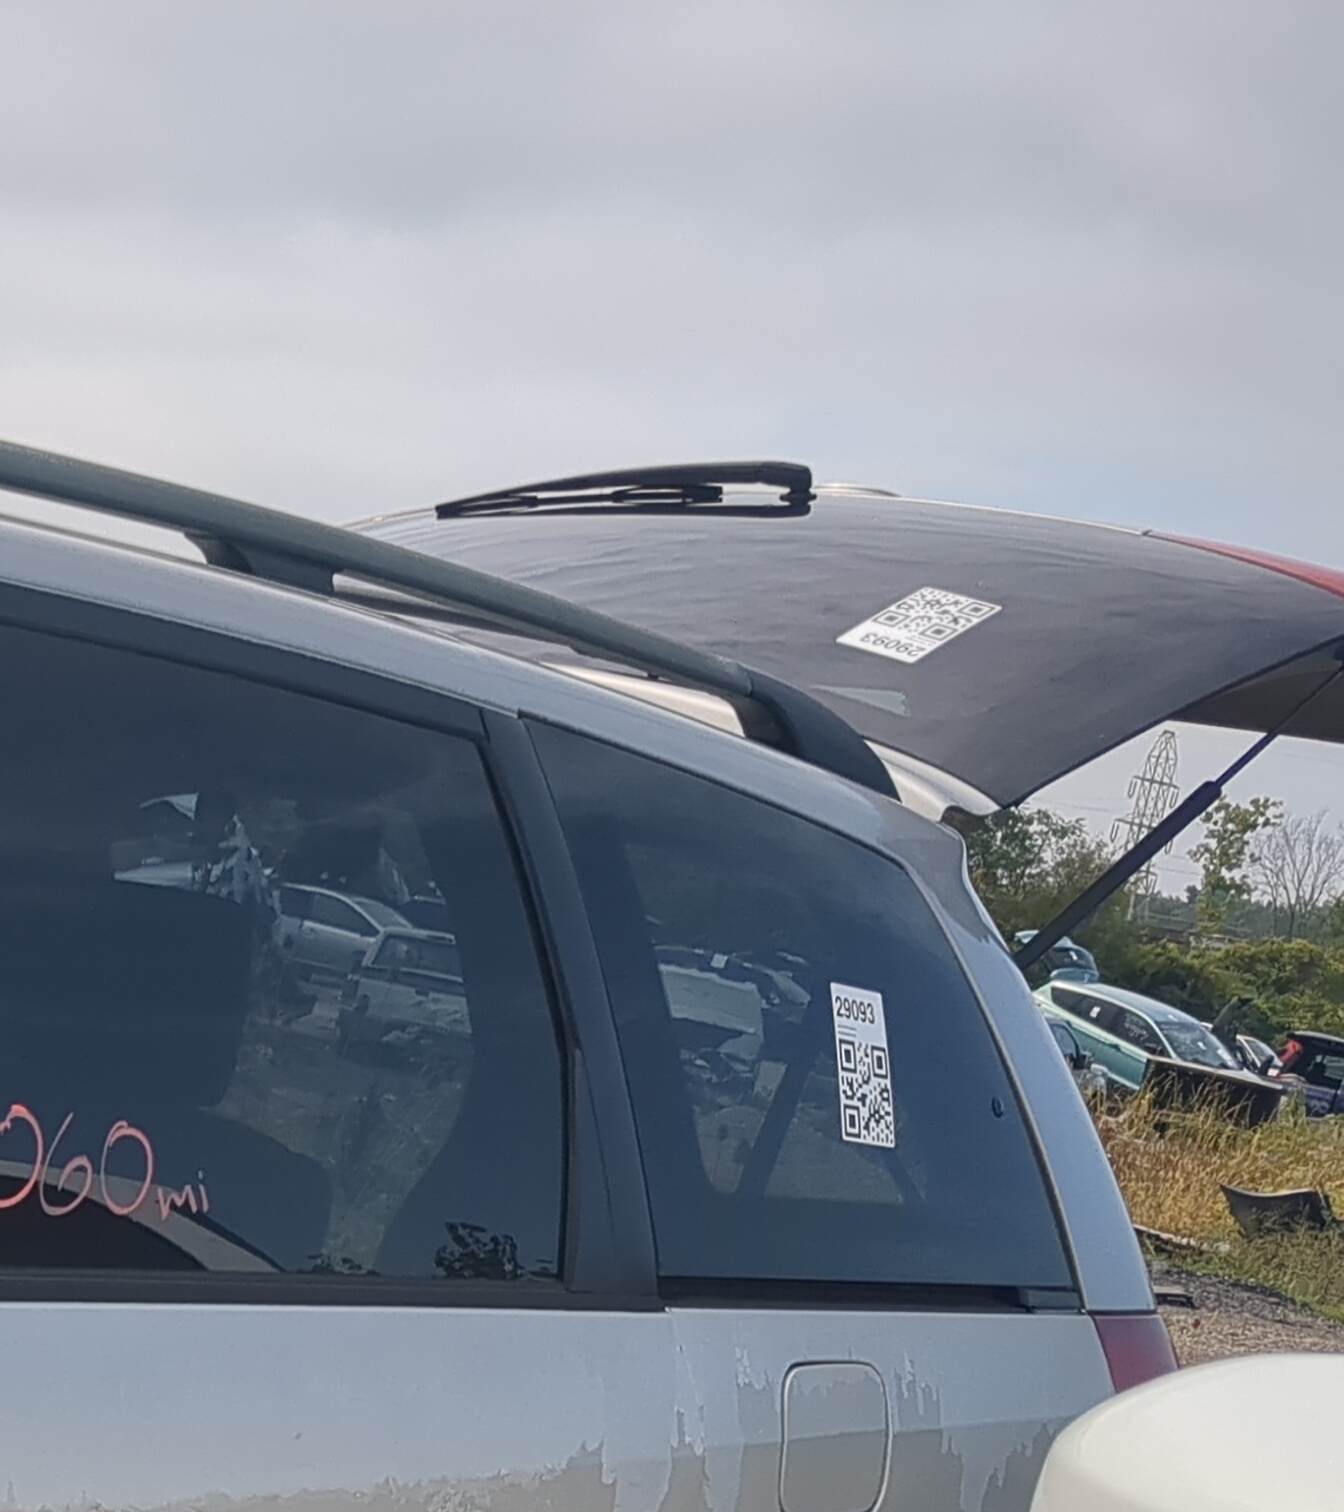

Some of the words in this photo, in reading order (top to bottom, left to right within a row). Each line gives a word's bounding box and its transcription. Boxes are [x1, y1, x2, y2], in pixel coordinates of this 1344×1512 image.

[860, 632, 926, 658] 29093
[834, 995, 875, 1025] 29093
[157, 1170, 209, 1222] mi
